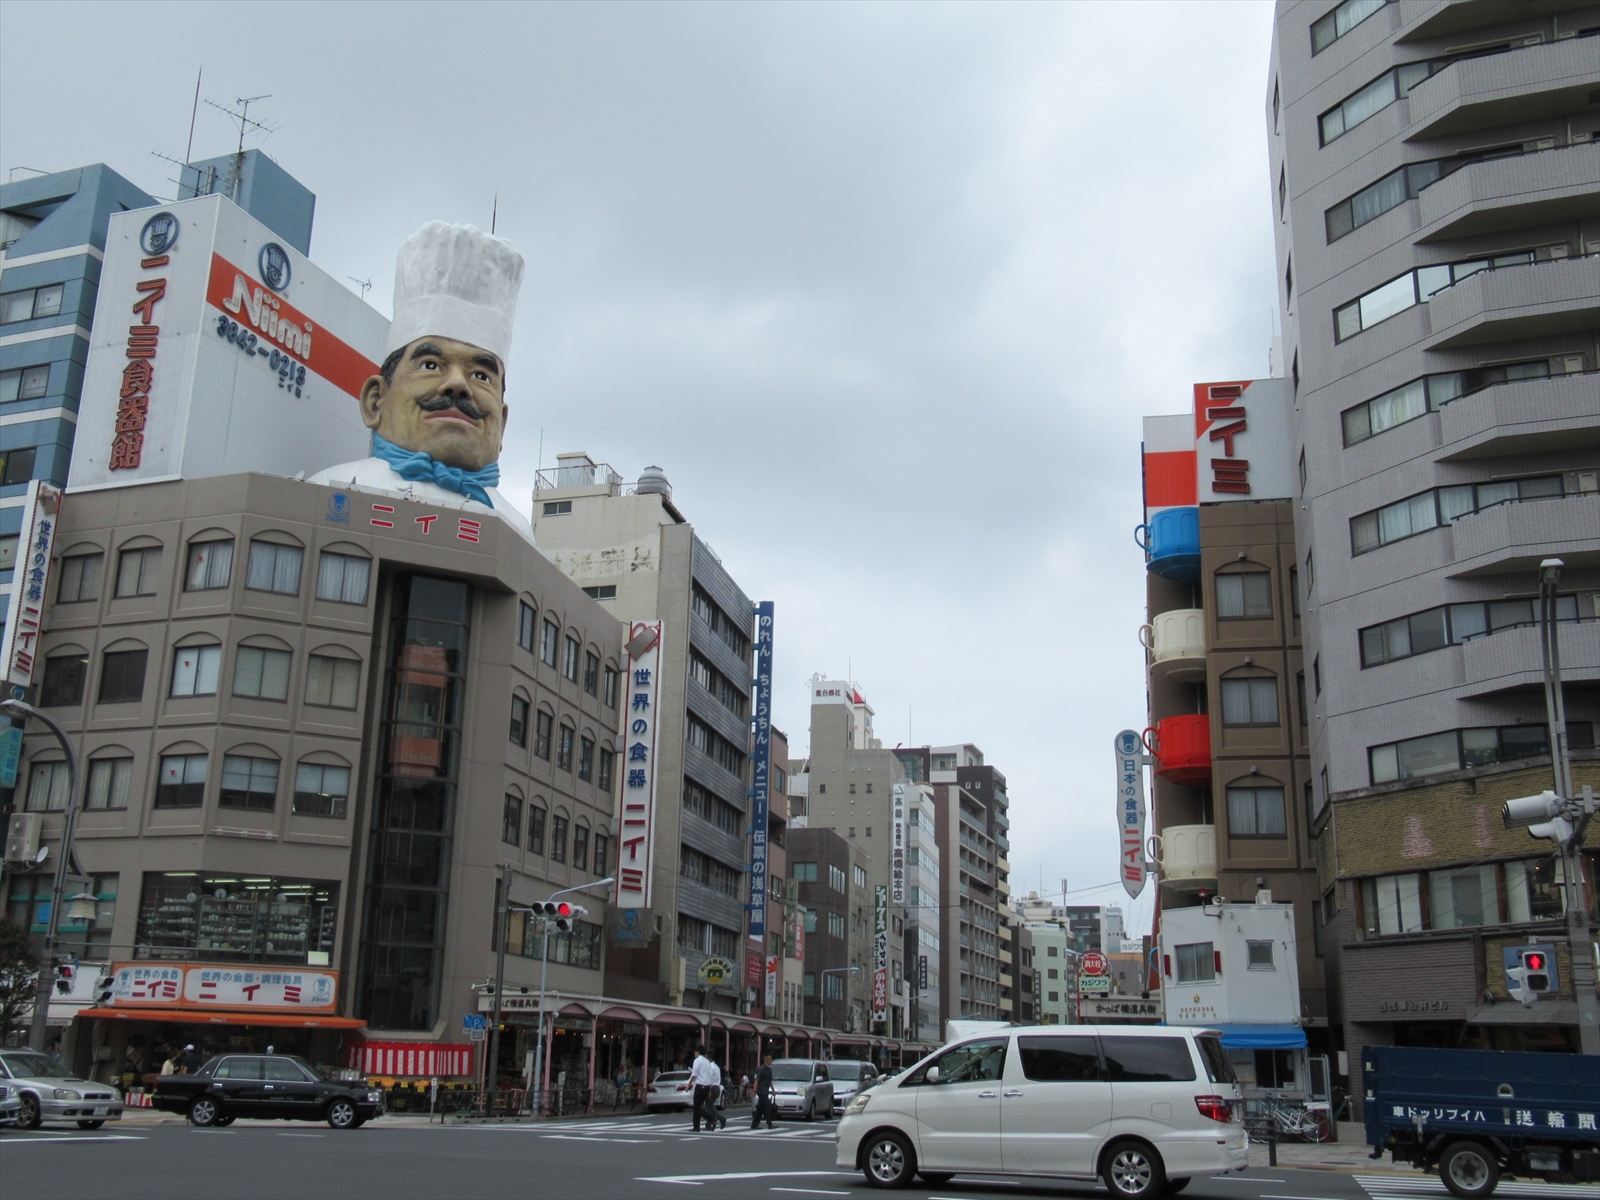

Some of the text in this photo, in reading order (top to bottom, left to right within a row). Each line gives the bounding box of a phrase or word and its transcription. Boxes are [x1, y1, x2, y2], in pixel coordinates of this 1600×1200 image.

[217, 315, 307, 386] 3842-0213
[222, 274, 313, 360] Niimi
[108, 254, 170, 471] ニイミ食器館
[1207, 385, 1250, 494] ニイミ
[370, 503, 481, 543] ニイミ
[27, 518, 53, 601] 世界の食器
[15, 606, 39, 675] ニイミ
[627, 667, 652, 788] 世界の食器
[1123, 759, 1139, 825] 日本の食器
[620, 803, 646, 893] ニイミ
[1124, 829, 1142, 882] ニイミ
[131, 980, 178, 998] ニイミ
[134, 969, 179, 980] 世界の食器
[199, 982, 302, 1003] ニイミ
